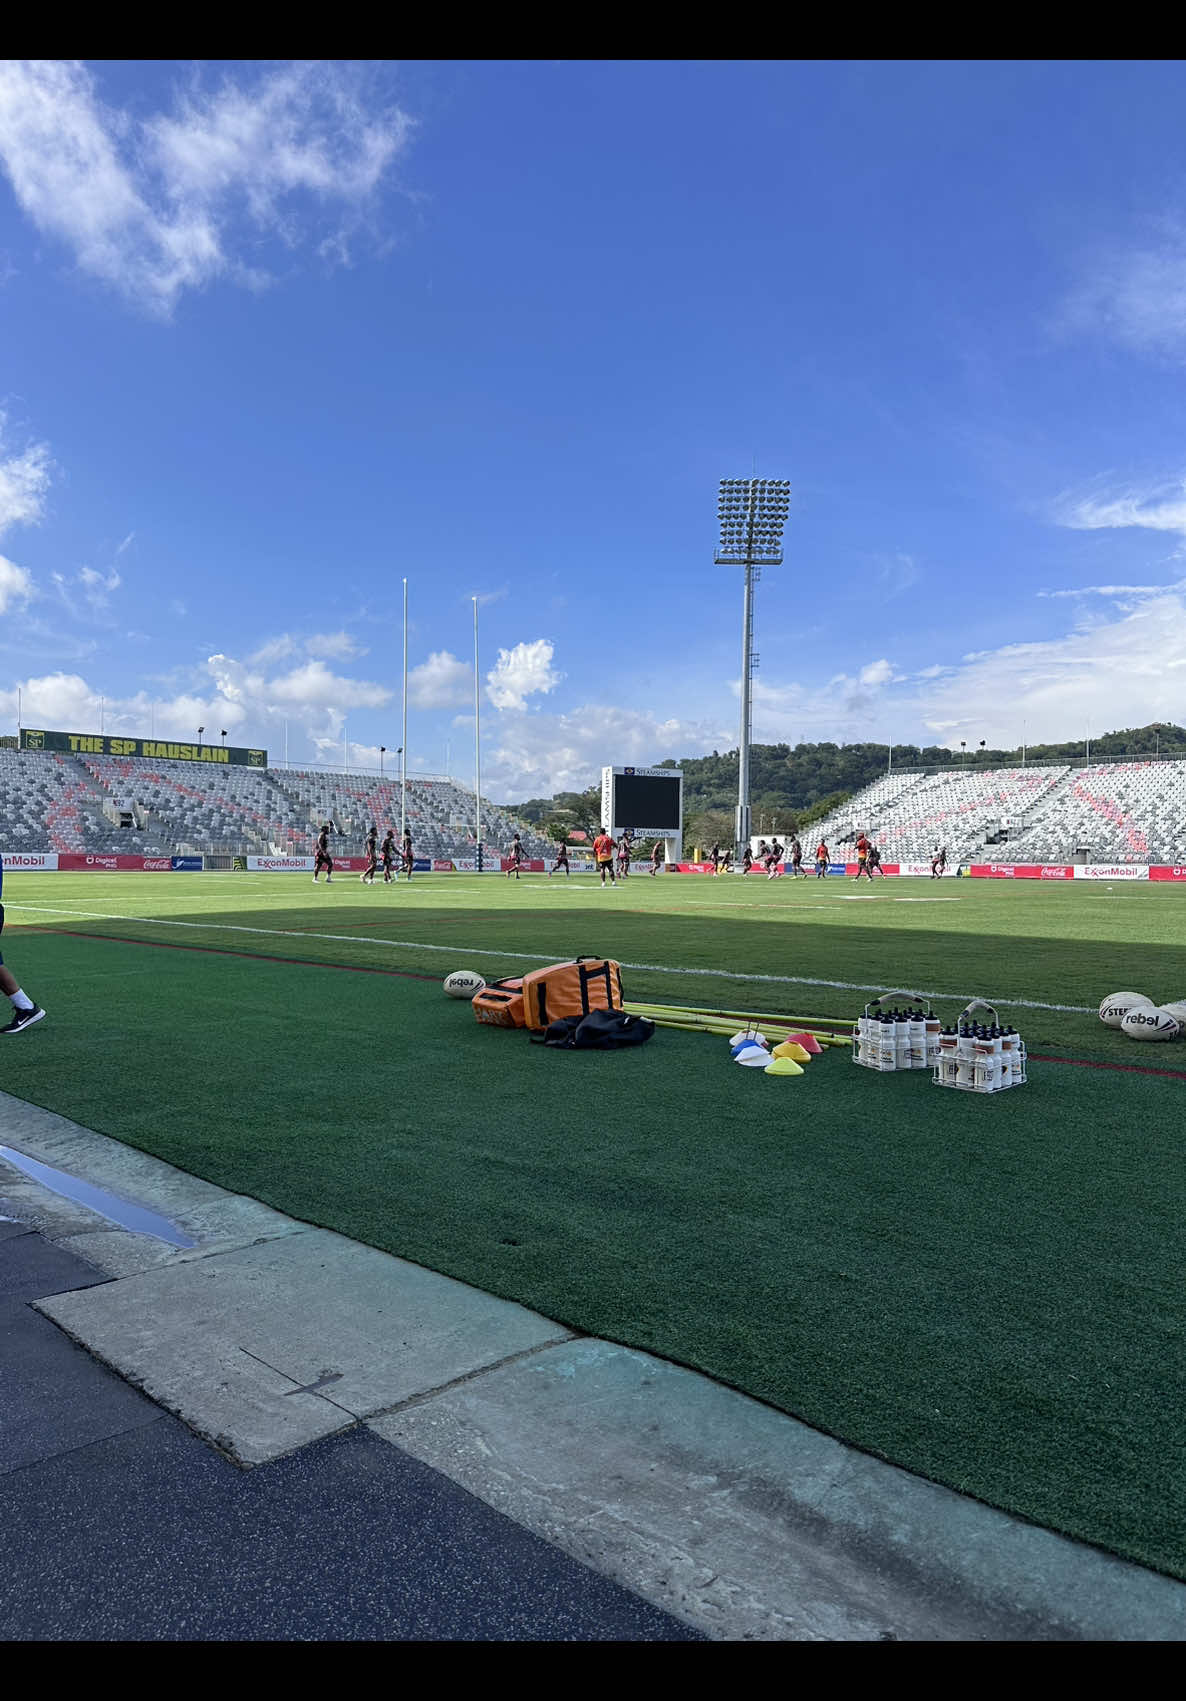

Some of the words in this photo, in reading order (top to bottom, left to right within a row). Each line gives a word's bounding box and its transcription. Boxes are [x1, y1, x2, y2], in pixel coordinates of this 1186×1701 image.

[68, 735, 104, 753] THE
[110, 739, 136, 756] SP
[142, 742, 230, 763] HAUSLAIN
[636, 768, 671, 777] STEAMSHIPS
[636, 829, 671, 838] STEAMSHIPS
[257, 858, 306, 869] ExxonMobil
[1084, 867, 1138, 877] ExxonMobil
[1126, 1013, 1160, 1026] rebel
